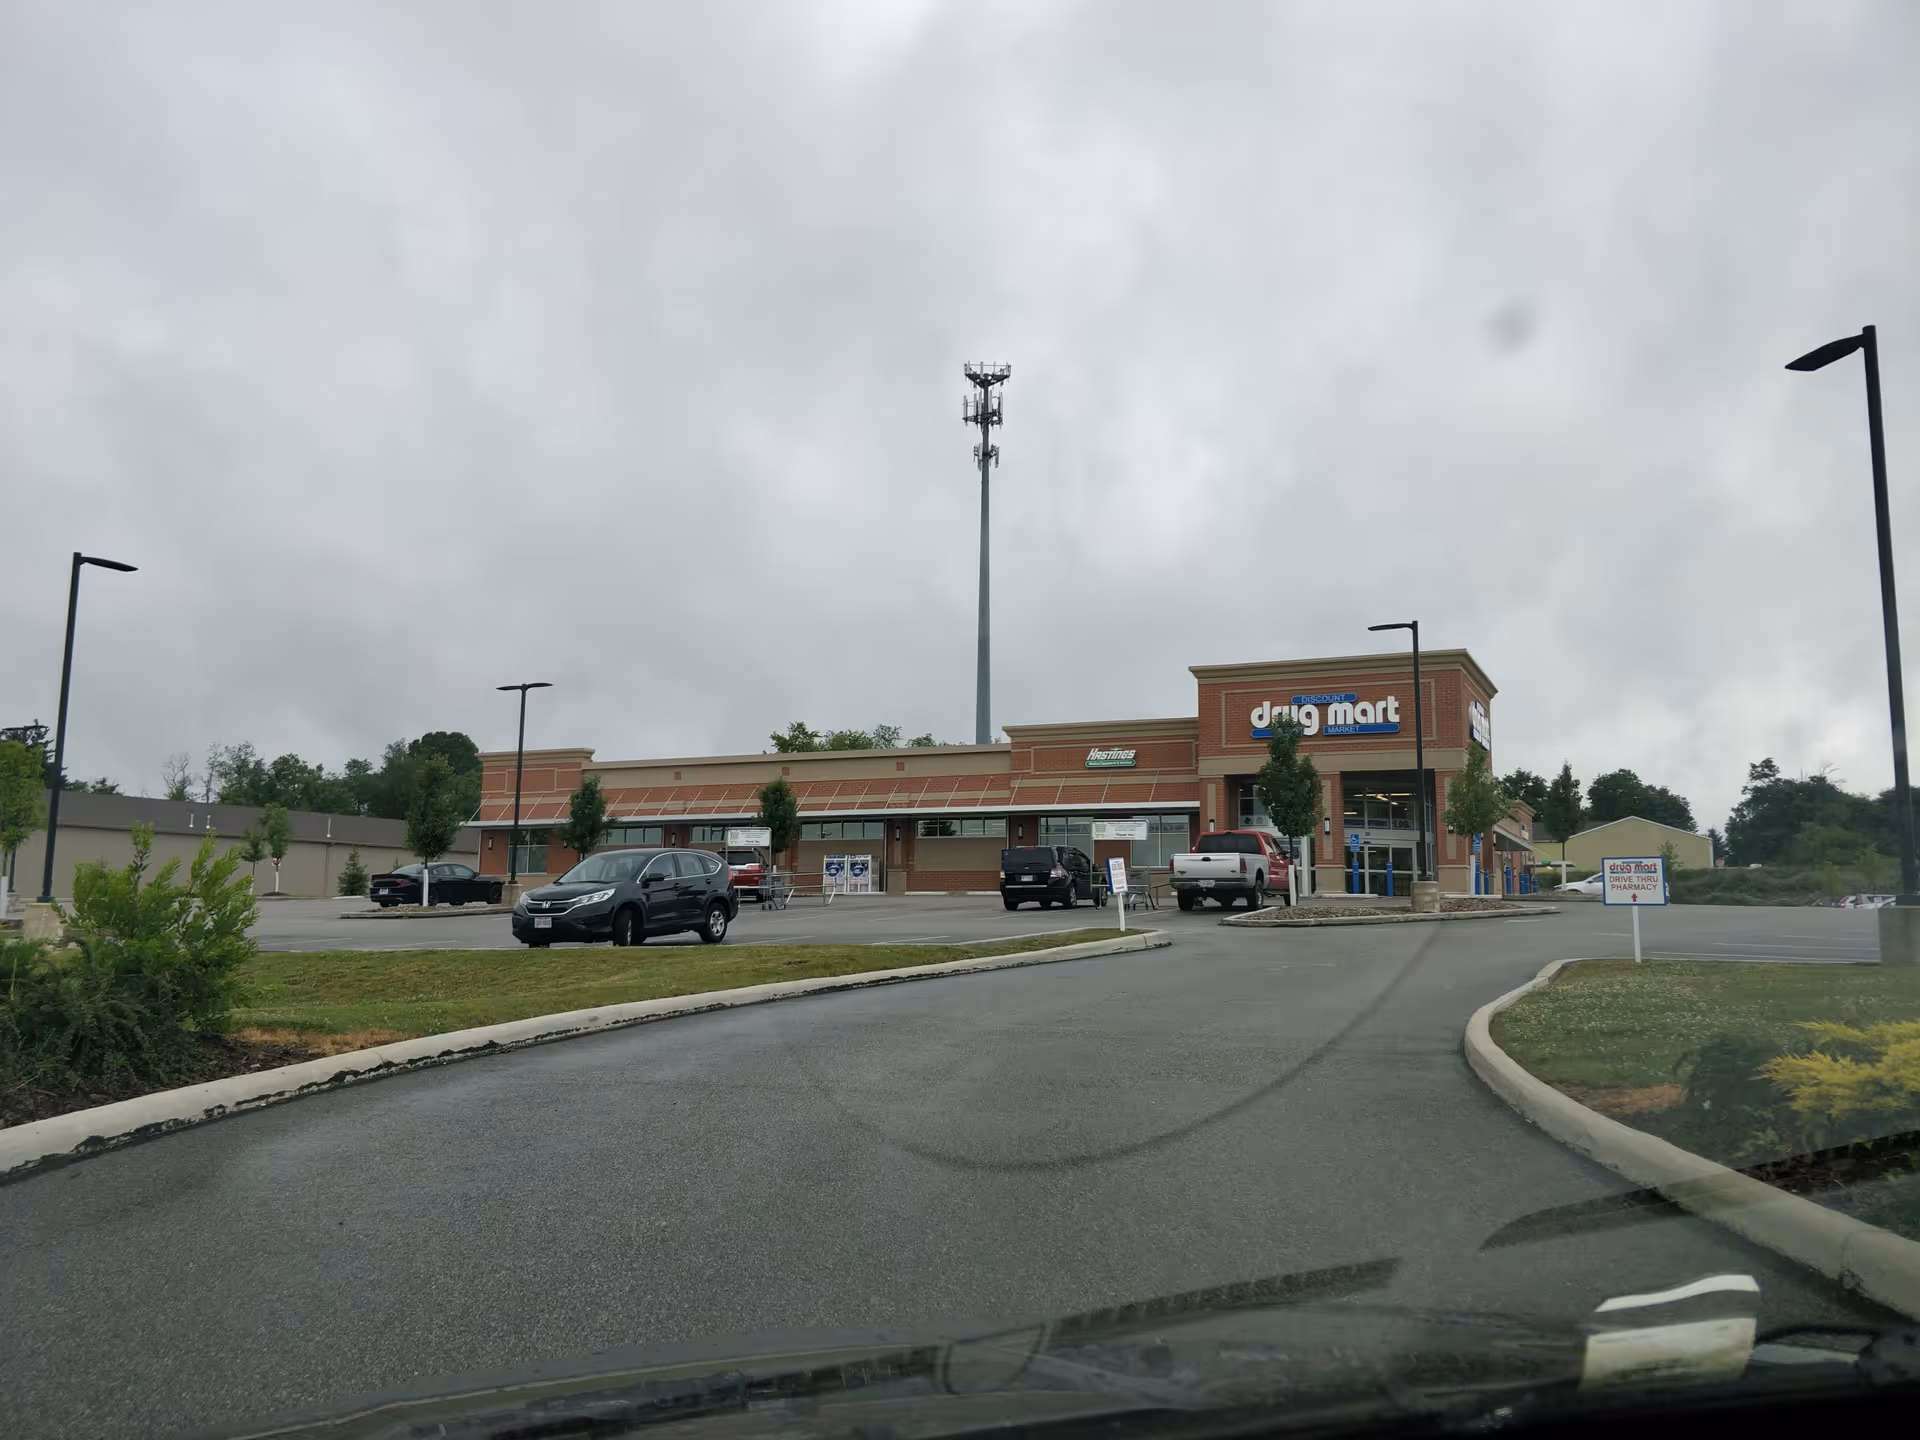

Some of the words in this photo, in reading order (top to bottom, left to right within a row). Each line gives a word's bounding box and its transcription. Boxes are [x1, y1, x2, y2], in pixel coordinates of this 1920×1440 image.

[1301, 694, 1346, 703] DISCOUNT
[1250, 701, 1320, 736] drug
[1327, 695, 1400, 725] mart
[1327, 725, 1360, 733] MARKET
[1609, 863, 1632, 873] drug
[1634, 863, 1657, 871] mart
